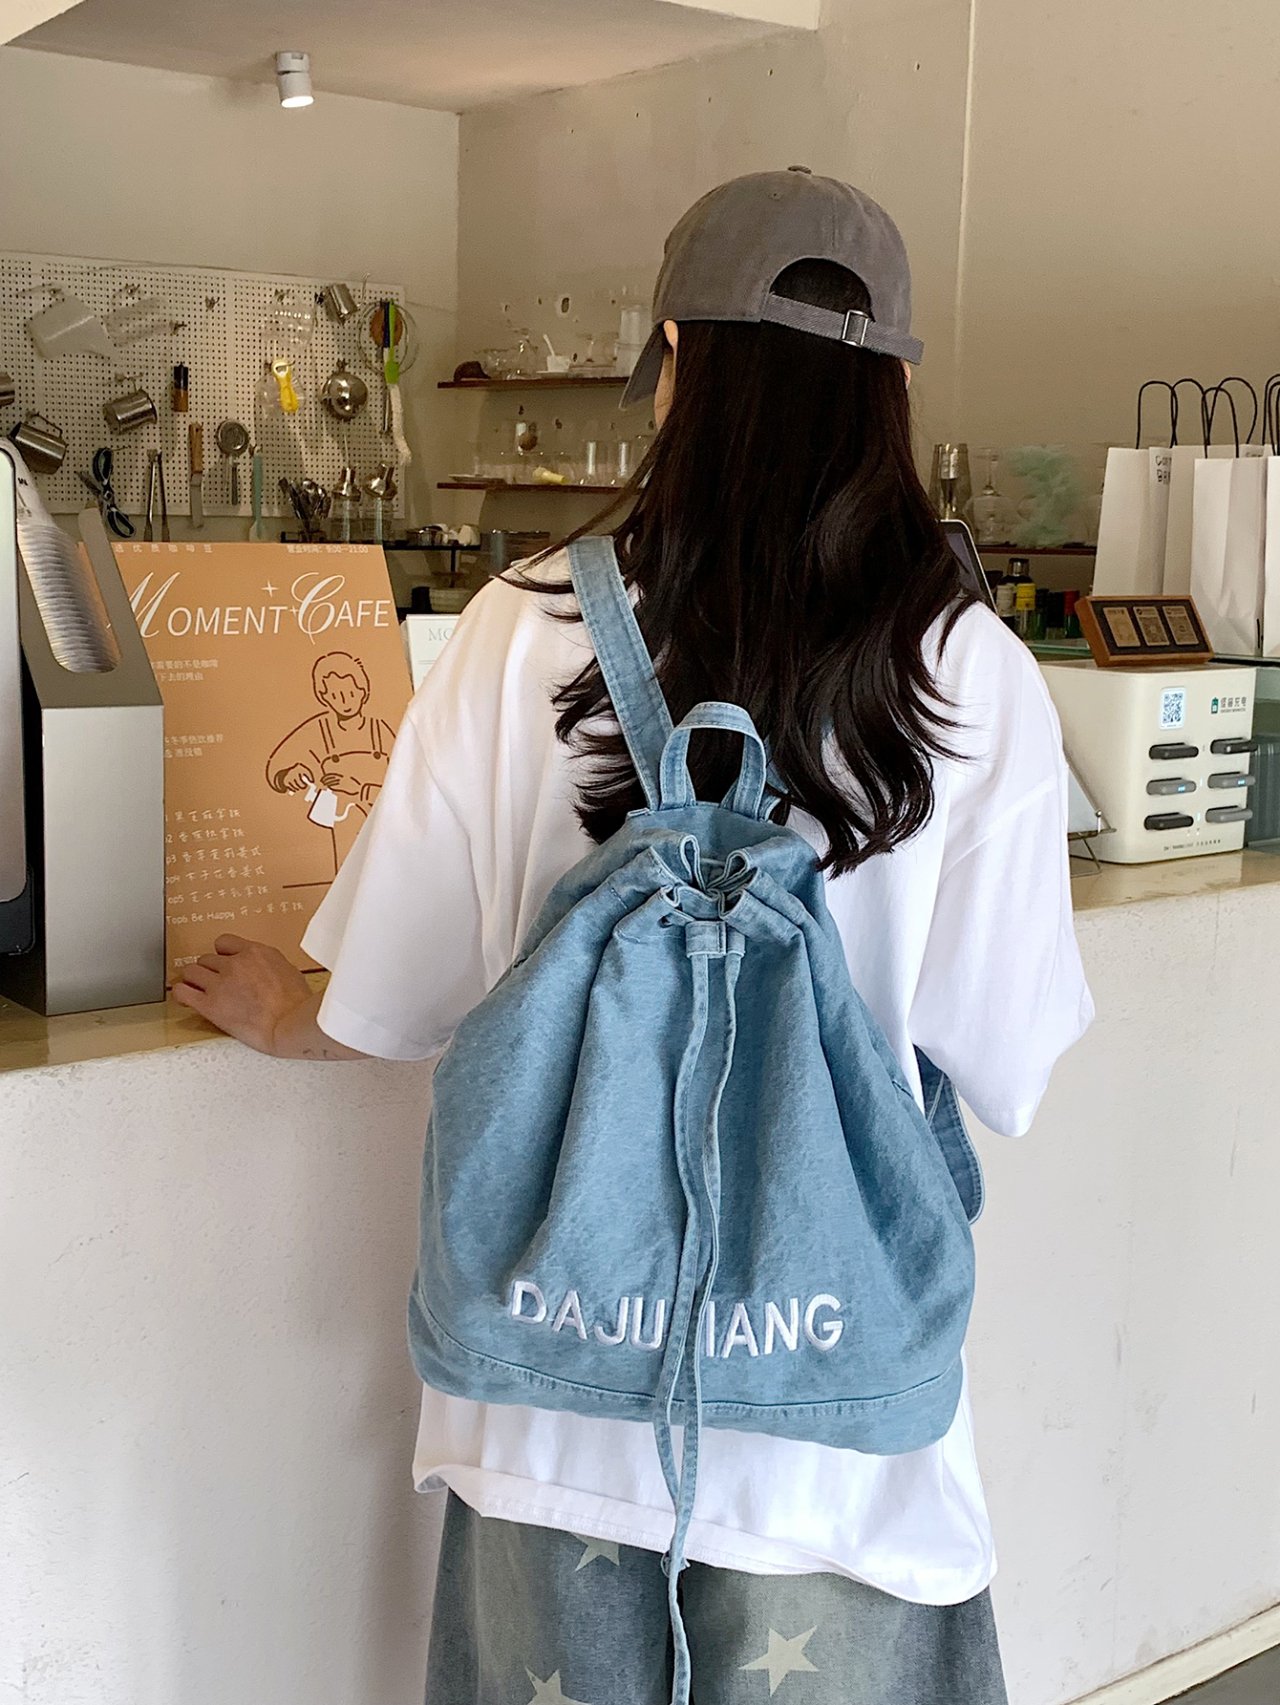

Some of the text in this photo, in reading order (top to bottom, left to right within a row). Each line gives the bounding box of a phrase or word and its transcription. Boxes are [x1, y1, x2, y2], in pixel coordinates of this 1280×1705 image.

[129, 571, 391, 645] MOMENT CAFE
[510, 1279, 844, 1359] DAJUIANG
